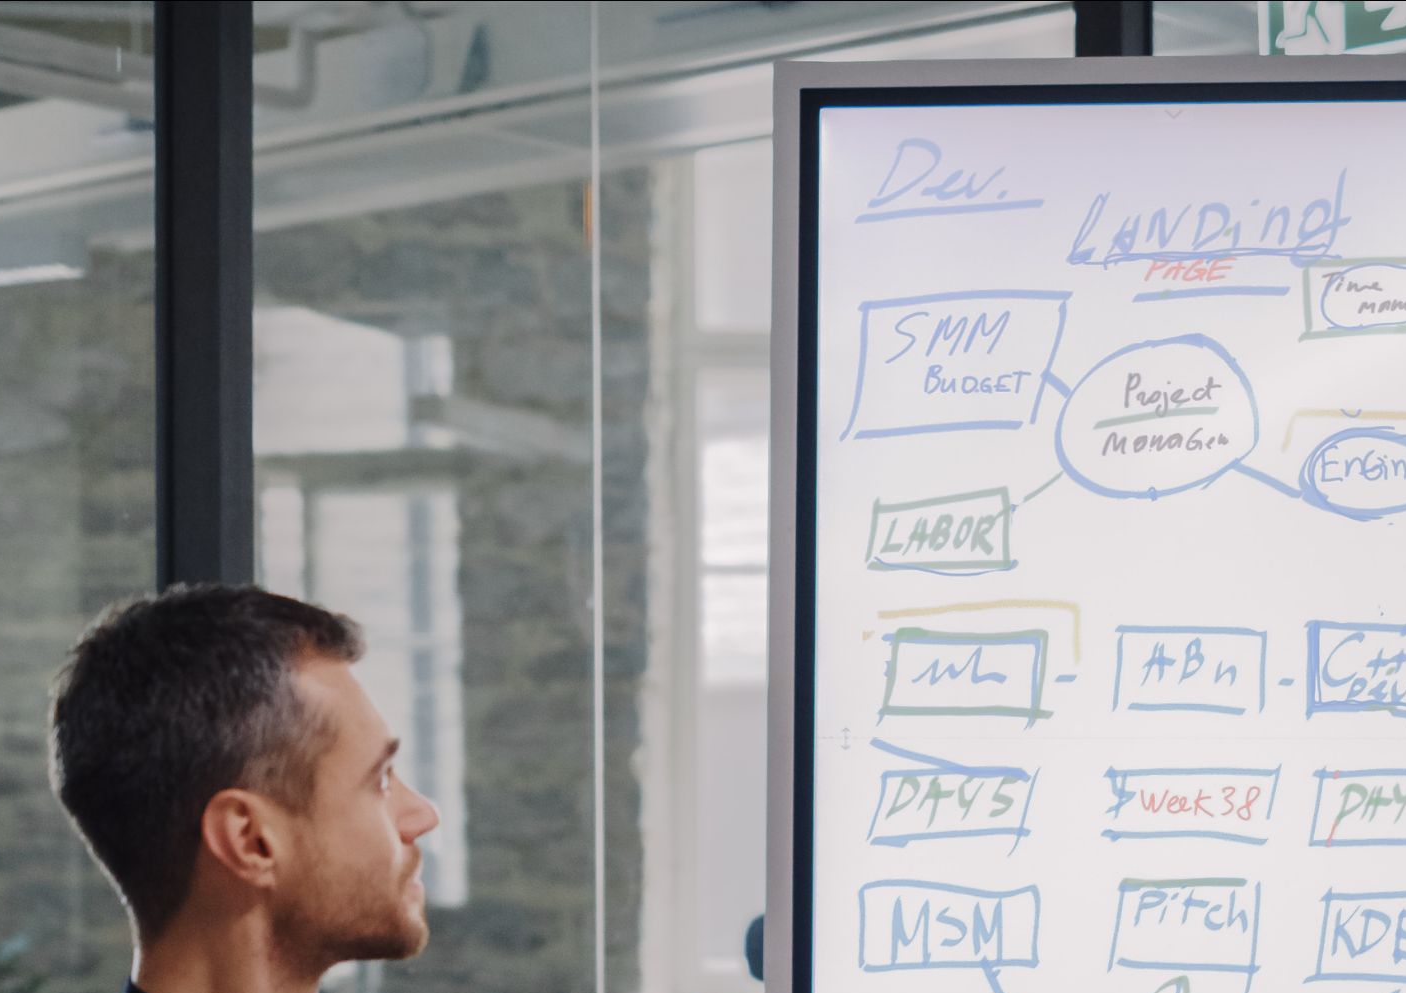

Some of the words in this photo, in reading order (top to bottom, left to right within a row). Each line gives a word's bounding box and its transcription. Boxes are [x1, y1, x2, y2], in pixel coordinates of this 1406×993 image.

[1145, 256, 1235, 282] PAGE
[885, 311, 1010, 363] SMM
[924, 364, 1032, 394] BUDGET
[1124, 373, 1222, 418] Project
[880, 514, 995, 556] LABOR
[1221, 786, 1261, 820] 38
[891, 895, 1003, 965] MSM
[1134, 889, 1248, 933] Pitch
